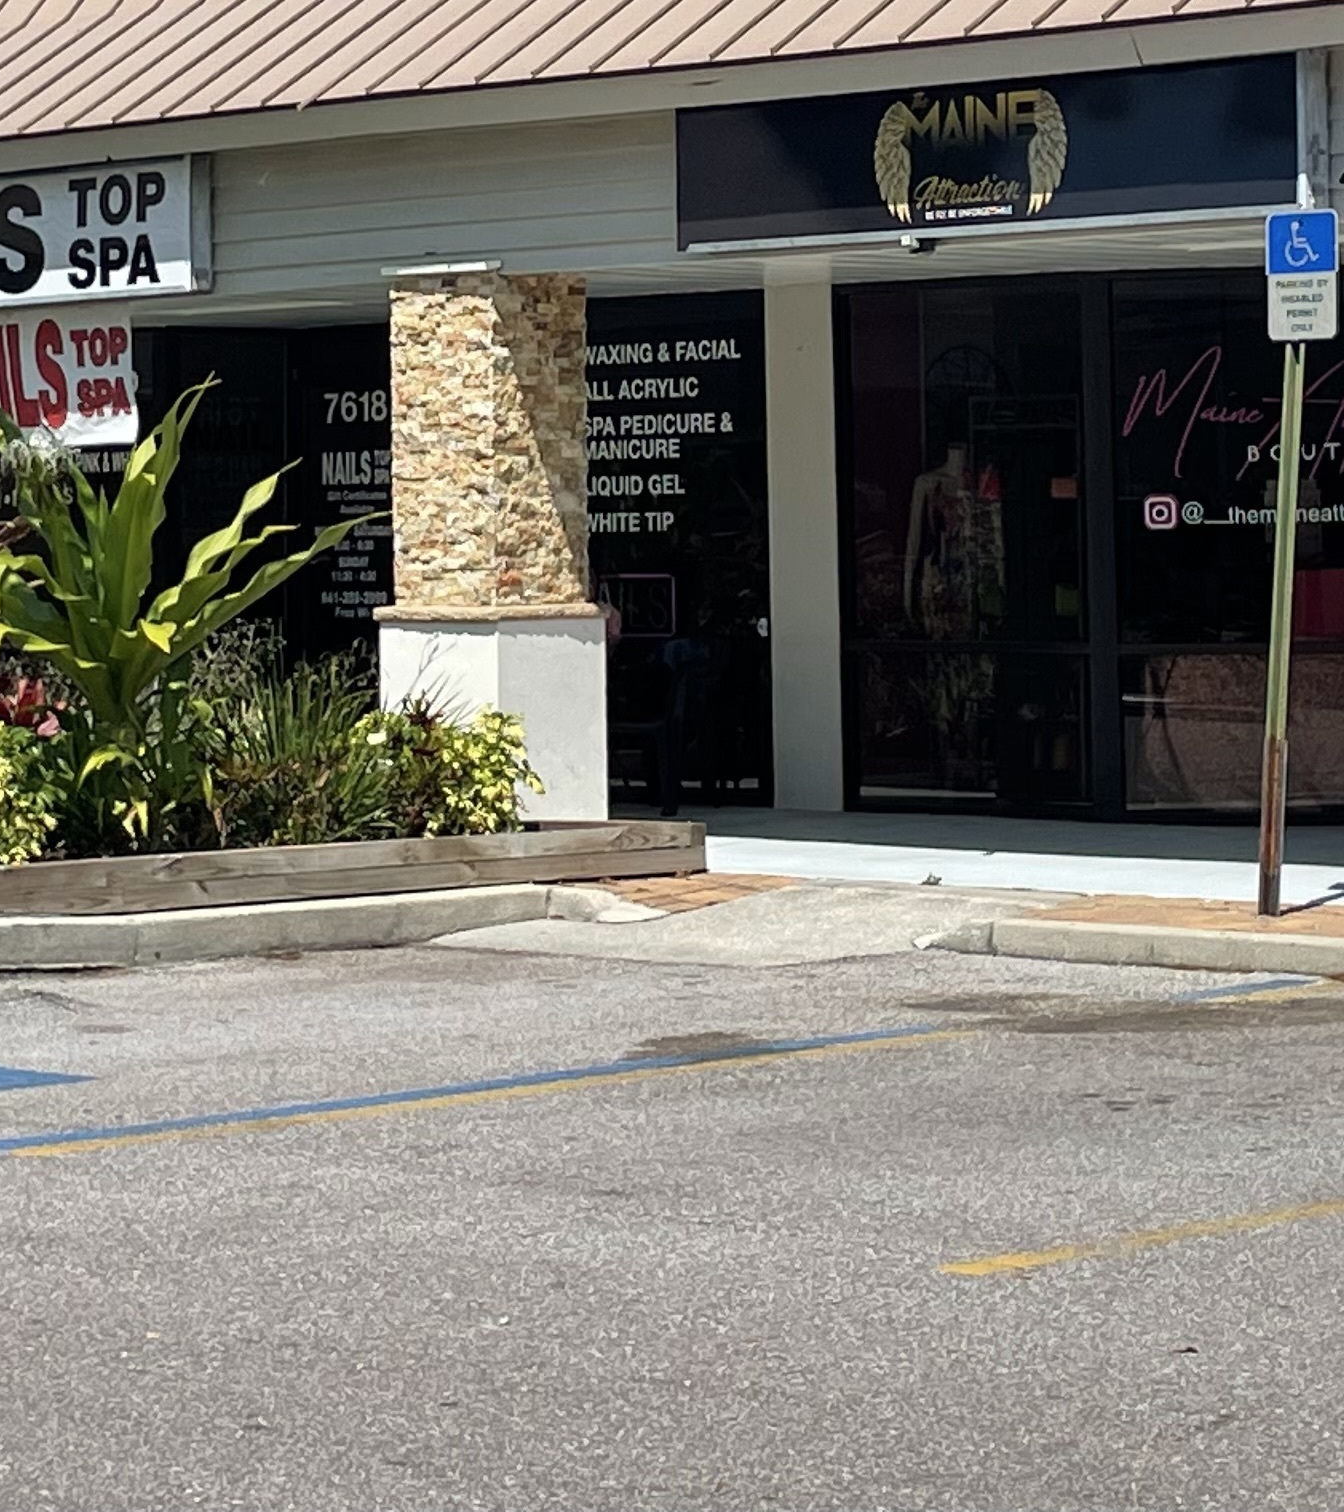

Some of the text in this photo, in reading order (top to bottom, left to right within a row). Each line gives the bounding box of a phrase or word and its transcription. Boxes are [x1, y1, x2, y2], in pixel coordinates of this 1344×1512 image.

[68, 170, 166, 228] TOP
[68, 233, 161, 289] SPA
[69, 326, 128, 368] TOP
[657, 341, 671, 363] &
[675, 338, 742, 362] FACIAL
[76, 376, 133, 418] SPA
[618, 376, 699, 400] ACRYLIC
[323, 389, 388, 424] 7618
[619, 412, 716, 436] PEDICURE
[719, 411, 734, 433] &
[321, 450, 372, 486] NAILS
[648, 473, 686, 495] GEL
[644, 511, 675, 532] TIP
